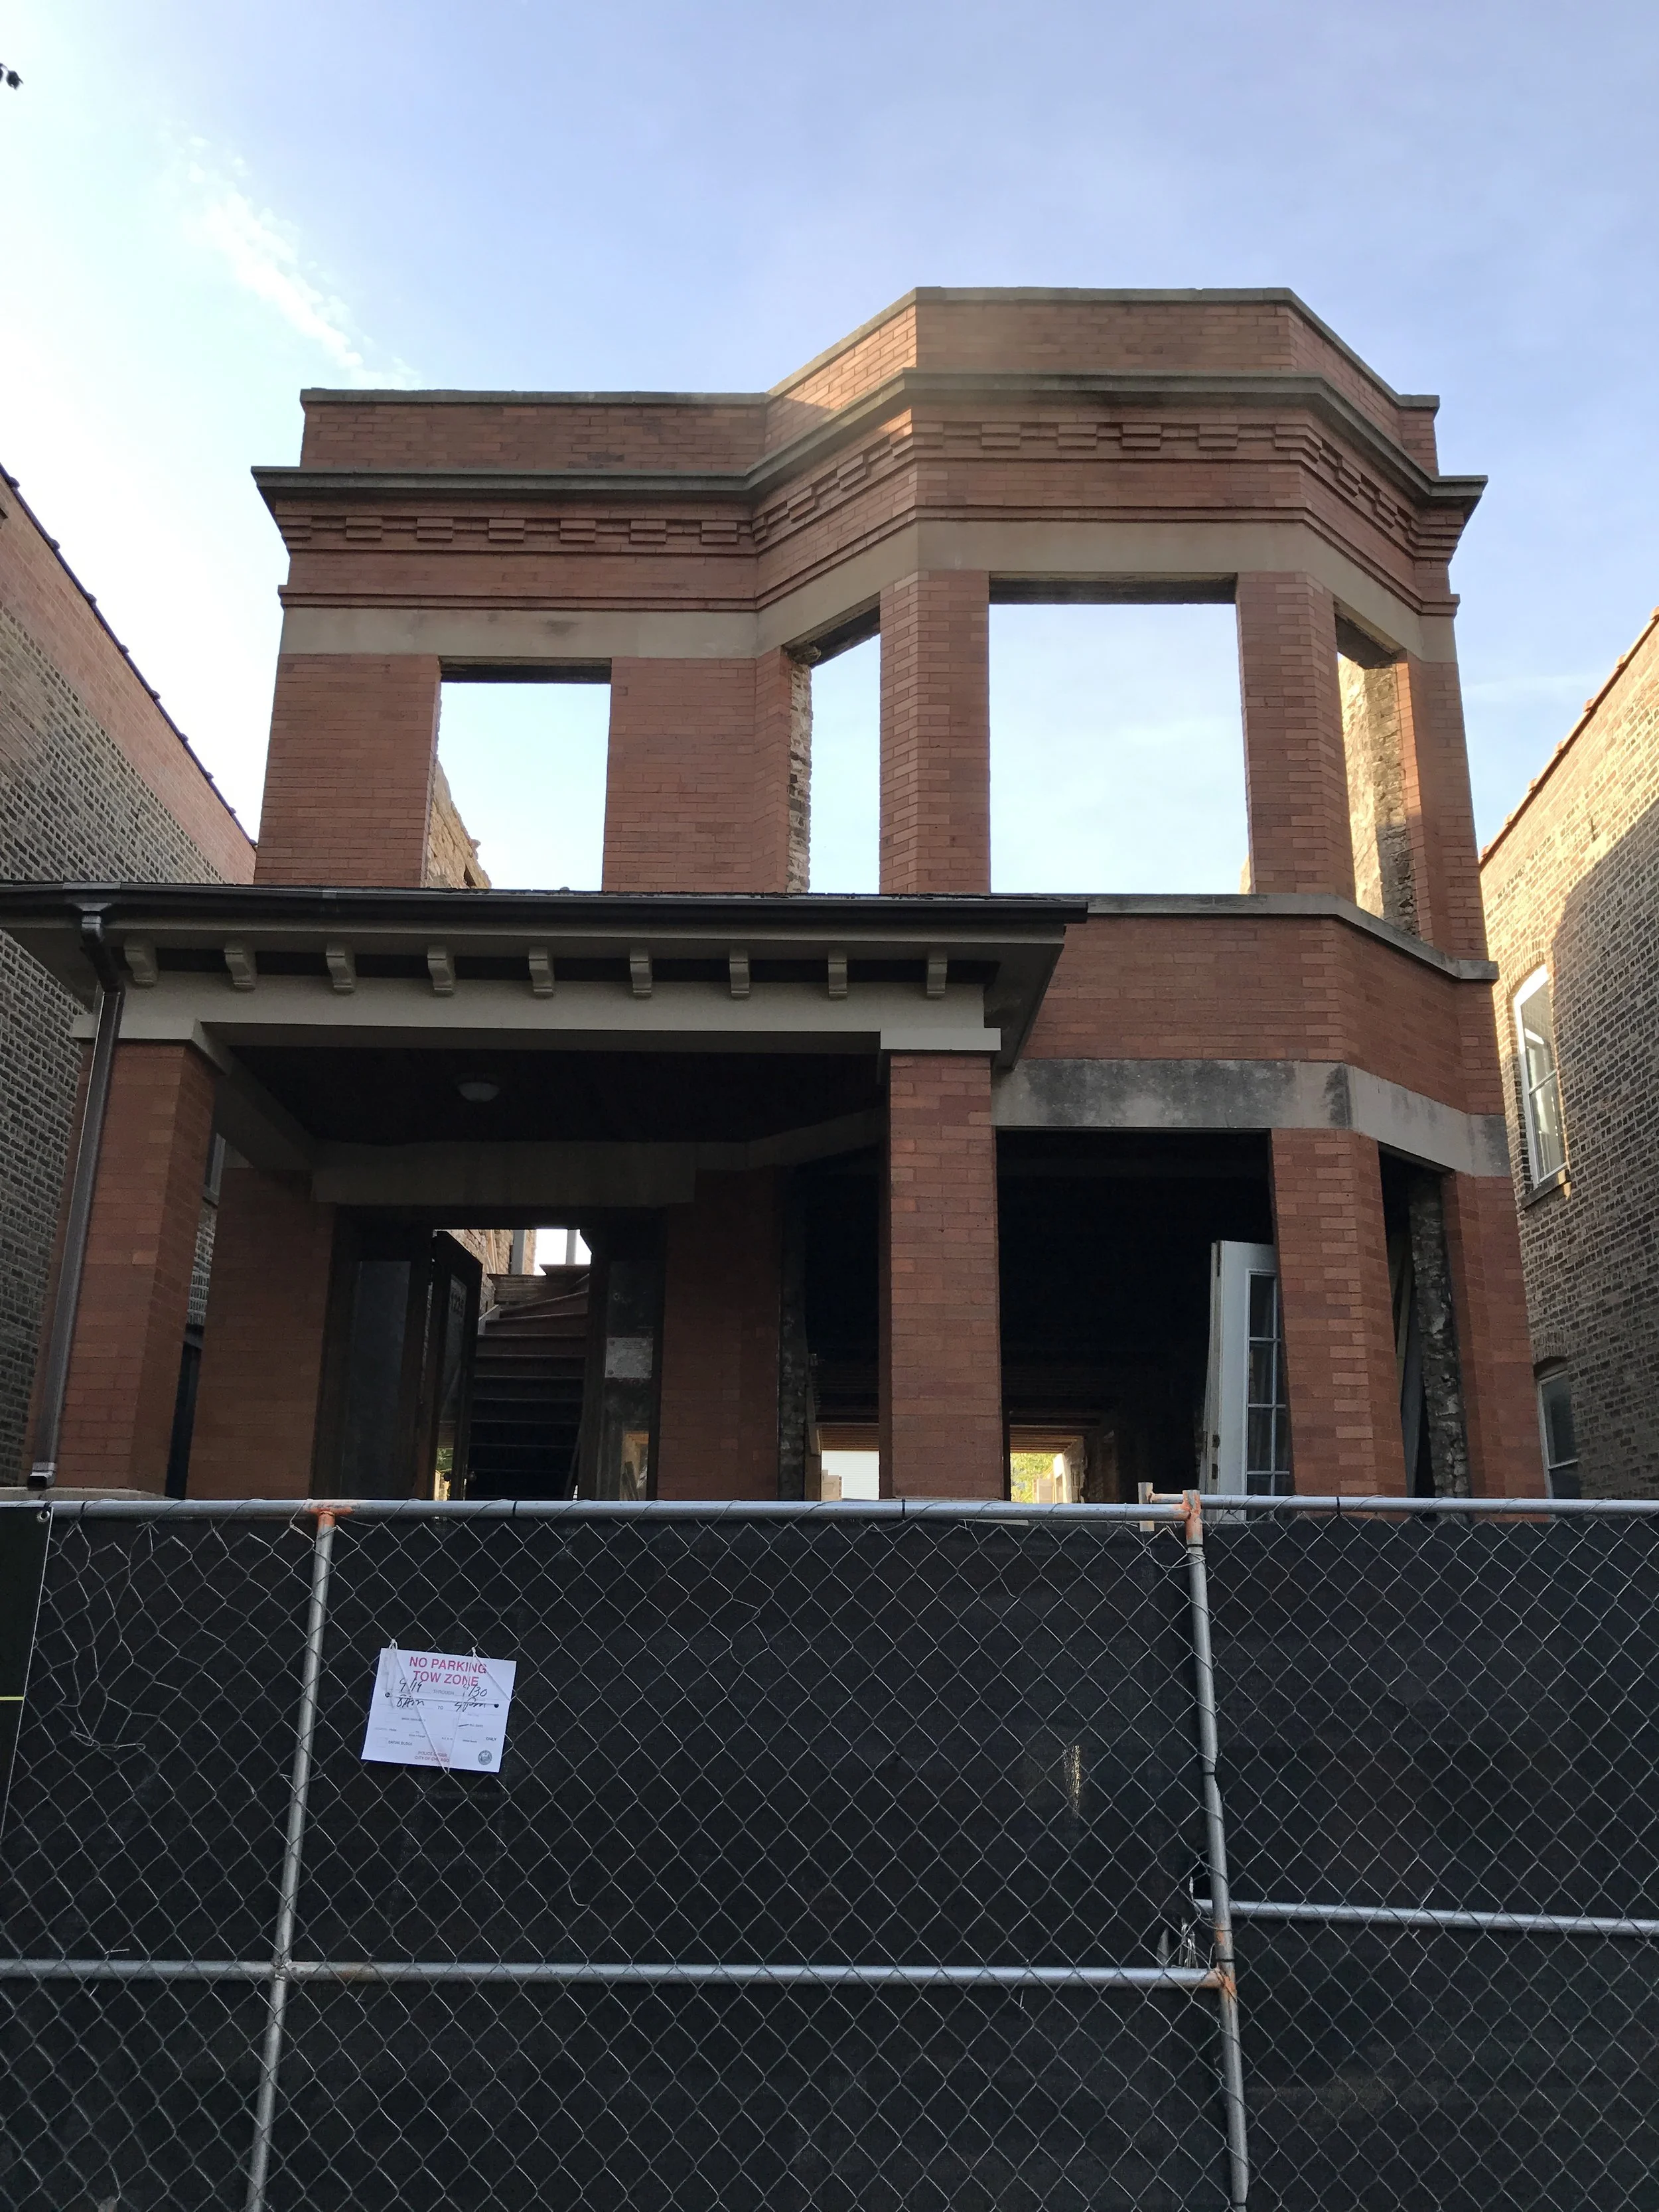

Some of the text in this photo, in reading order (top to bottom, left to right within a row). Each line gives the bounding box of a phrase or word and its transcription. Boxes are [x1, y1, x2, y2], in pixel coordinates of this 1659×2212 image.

[409, 1657, 487, 1674] NO PARKING
[413, 1670, 479, 1686] TOW ZONE
